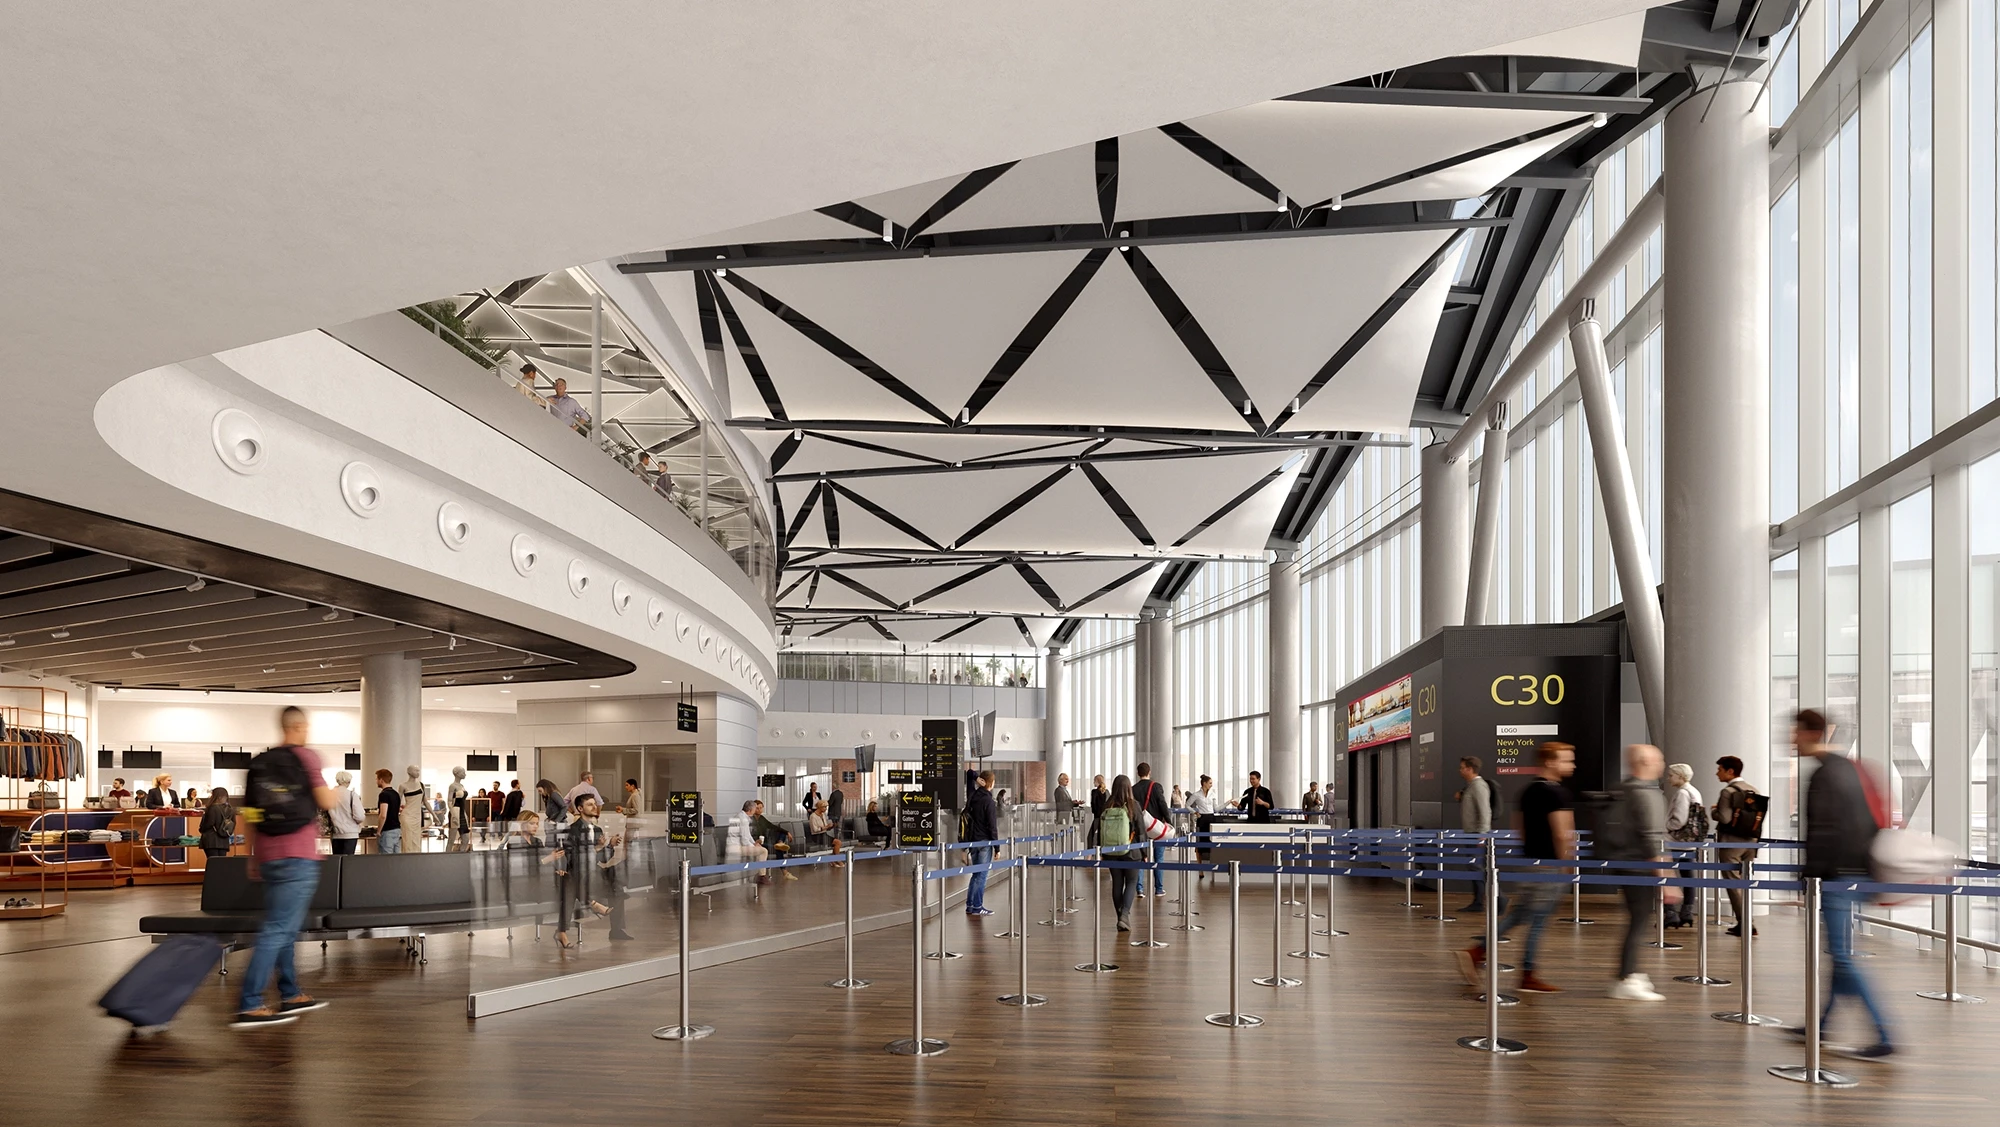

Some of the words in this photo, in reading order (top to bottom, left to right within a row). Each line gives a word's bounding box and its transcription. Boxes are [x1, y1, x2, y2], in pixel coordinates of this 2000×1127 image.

[1490, 674, 1565, 706] C30
[1418, 684, 1436, 717] C30
[1516, 738, 1534, 746] York
[1497, 748, 1519, 756] 18:50
[681, 792, 697, 800] E-gates
[913, 795, 932, 804] Priority
[686, 819, 697, 828] C30
[920, 819, 933, 829] C30
[671, 833, 687, 841] Priority
[901, 834, 922, 842] General
